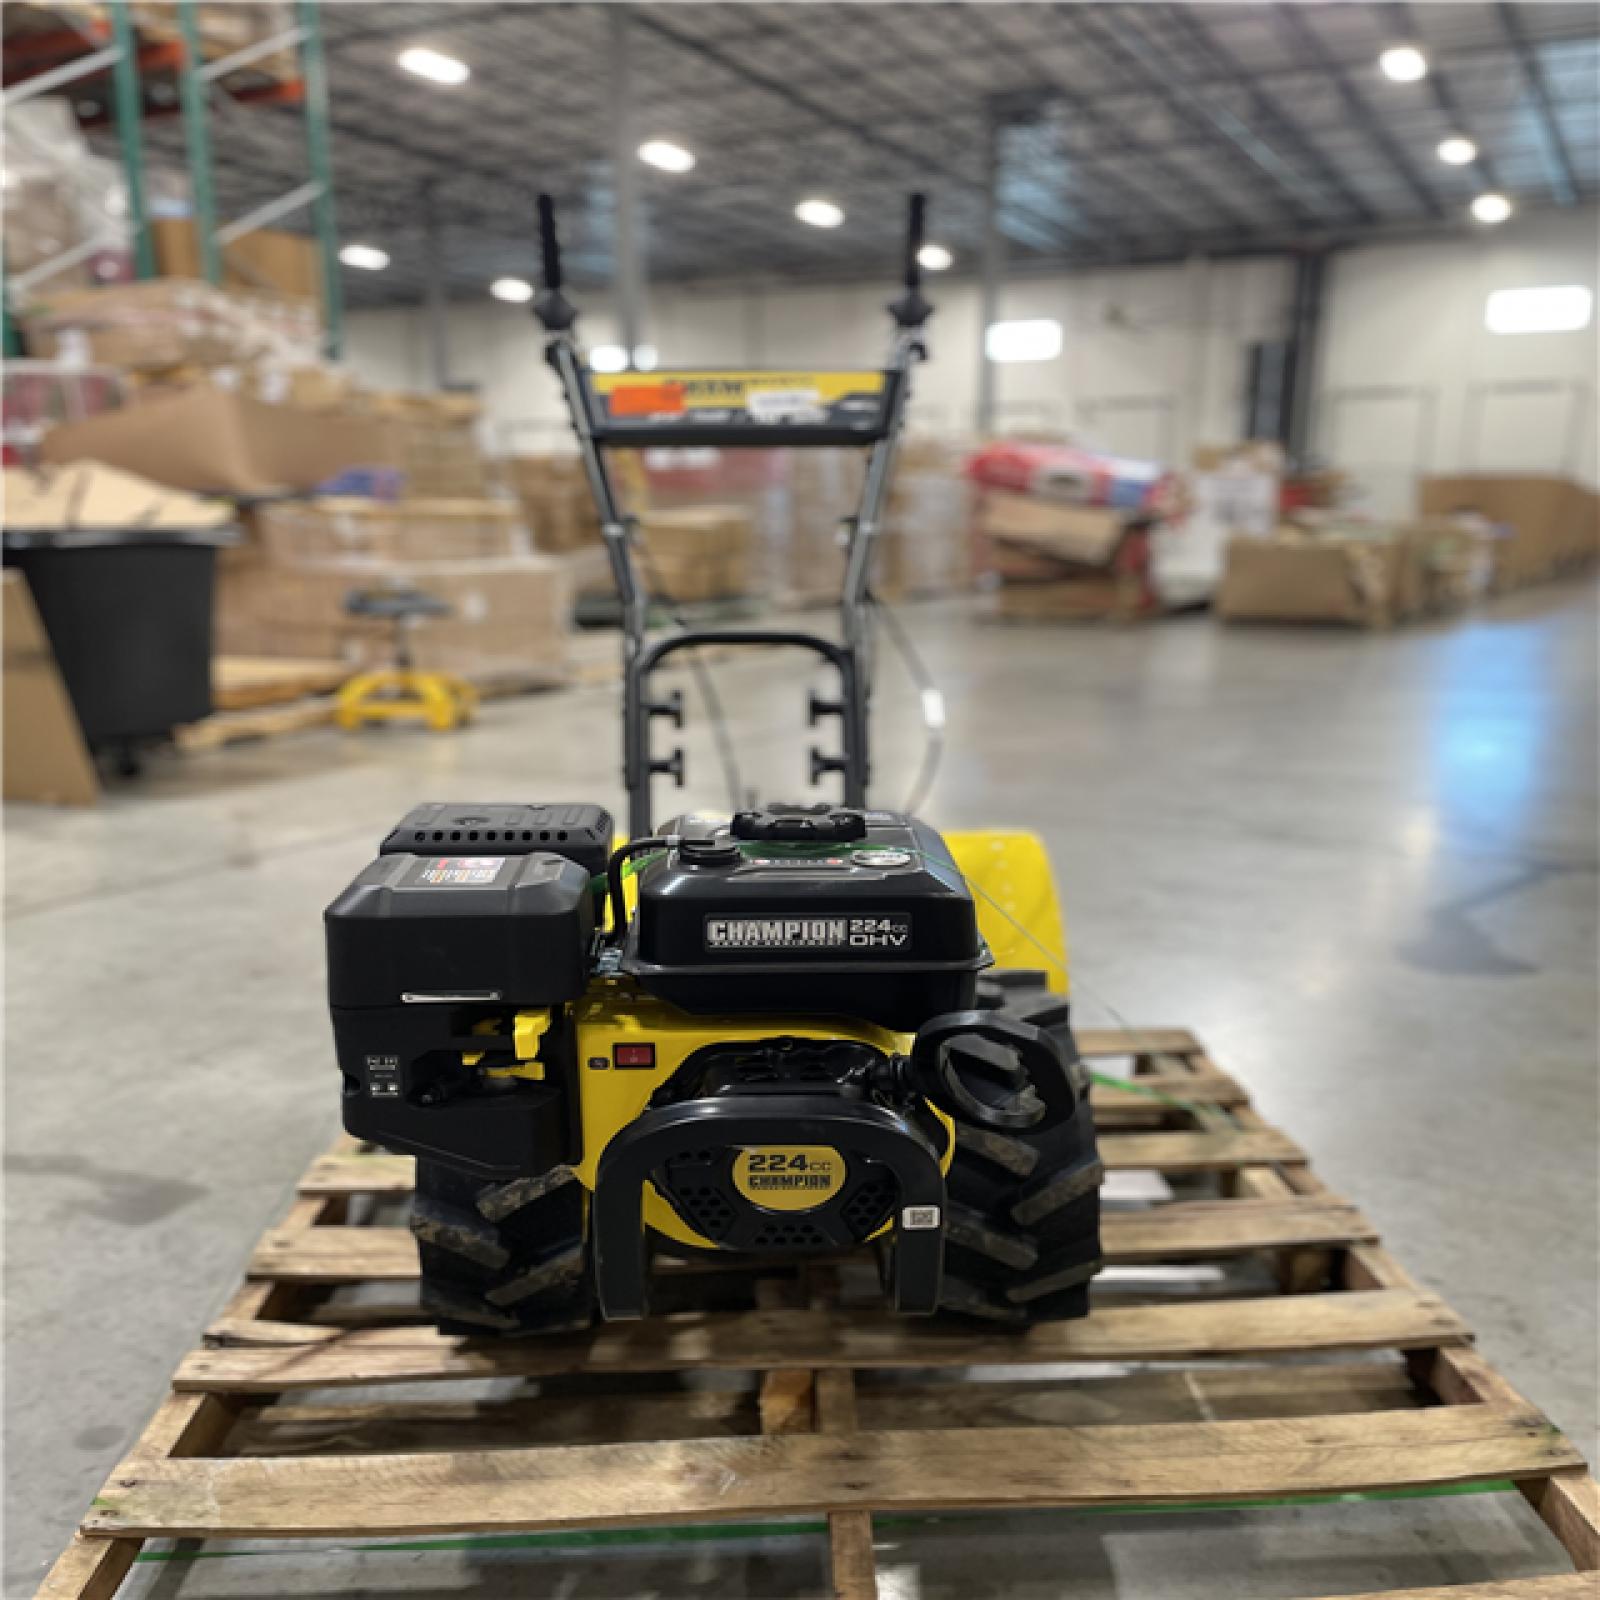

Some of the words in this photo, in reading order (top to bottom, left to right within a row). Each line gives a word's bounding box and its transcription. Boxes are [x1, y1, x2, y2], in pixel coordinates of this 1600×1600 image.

[707, 919, 848, 941] CHAMPION
[849, 934, 908, 946] OHV
[749, 1174, 831, 1186] CHAMPION
